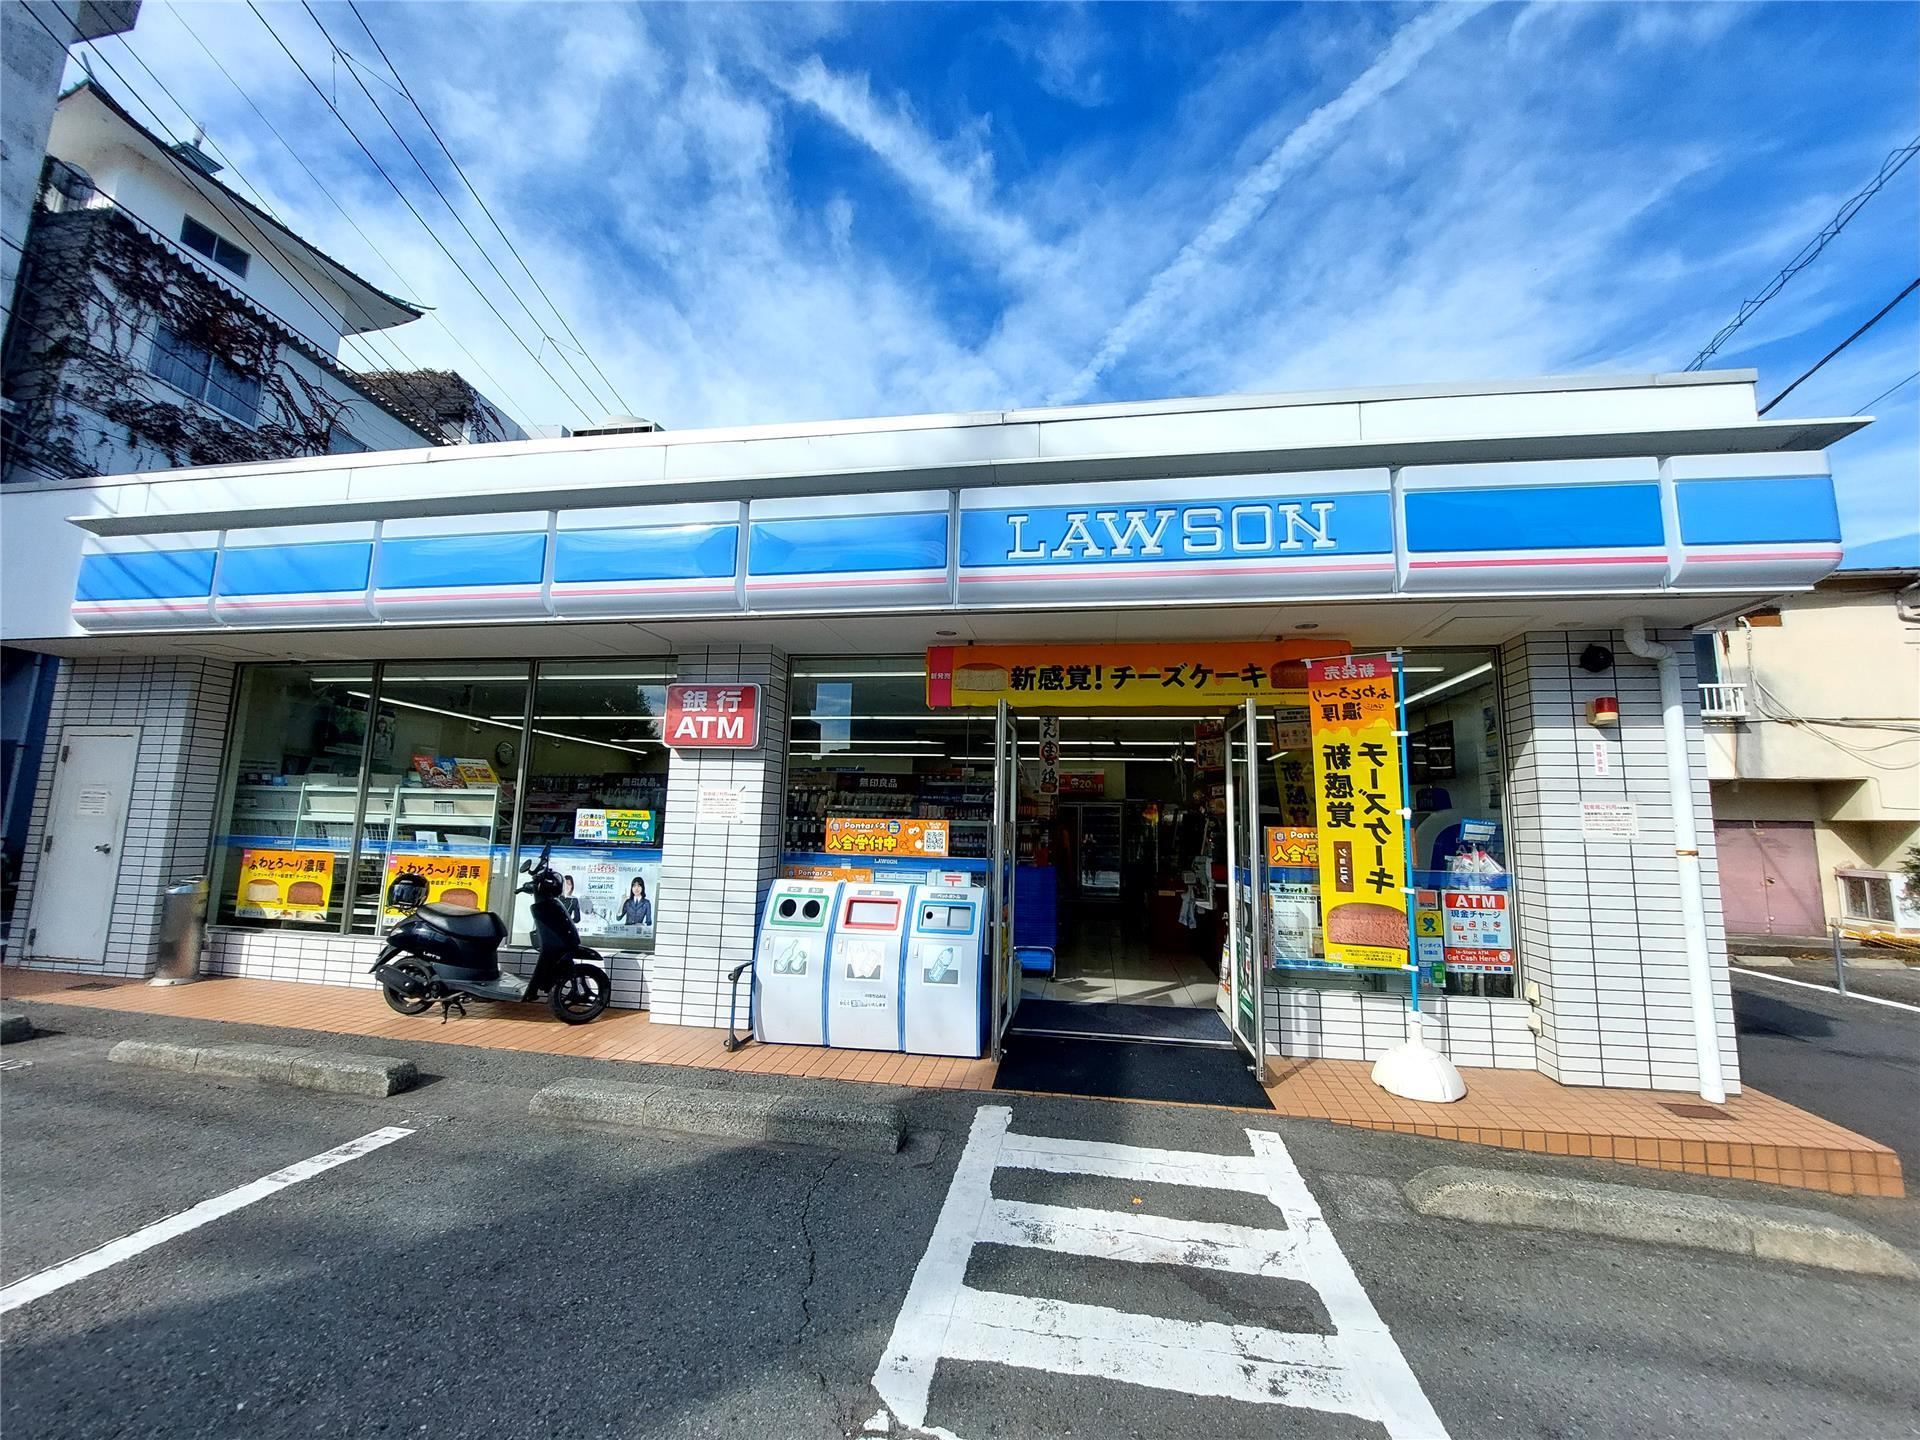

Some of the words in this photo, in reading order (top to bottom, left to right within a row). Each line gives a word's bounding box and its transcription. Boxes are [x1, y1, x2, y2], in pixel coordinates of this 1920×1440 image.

[1007, 501, 1338, 560] LAWSON
[682, 690, 742, 713] 銀行
[674, 716, 744, 739] ATM
[859, 778, 898, 788] 無印良品
[844, 820, 887, 829] Pontaパス
[828, 833, 898, 851] 入会受付中
[1455, 895, 1496, 908] ATM
[1451, 909, 1501, 919] 現金チャージ
